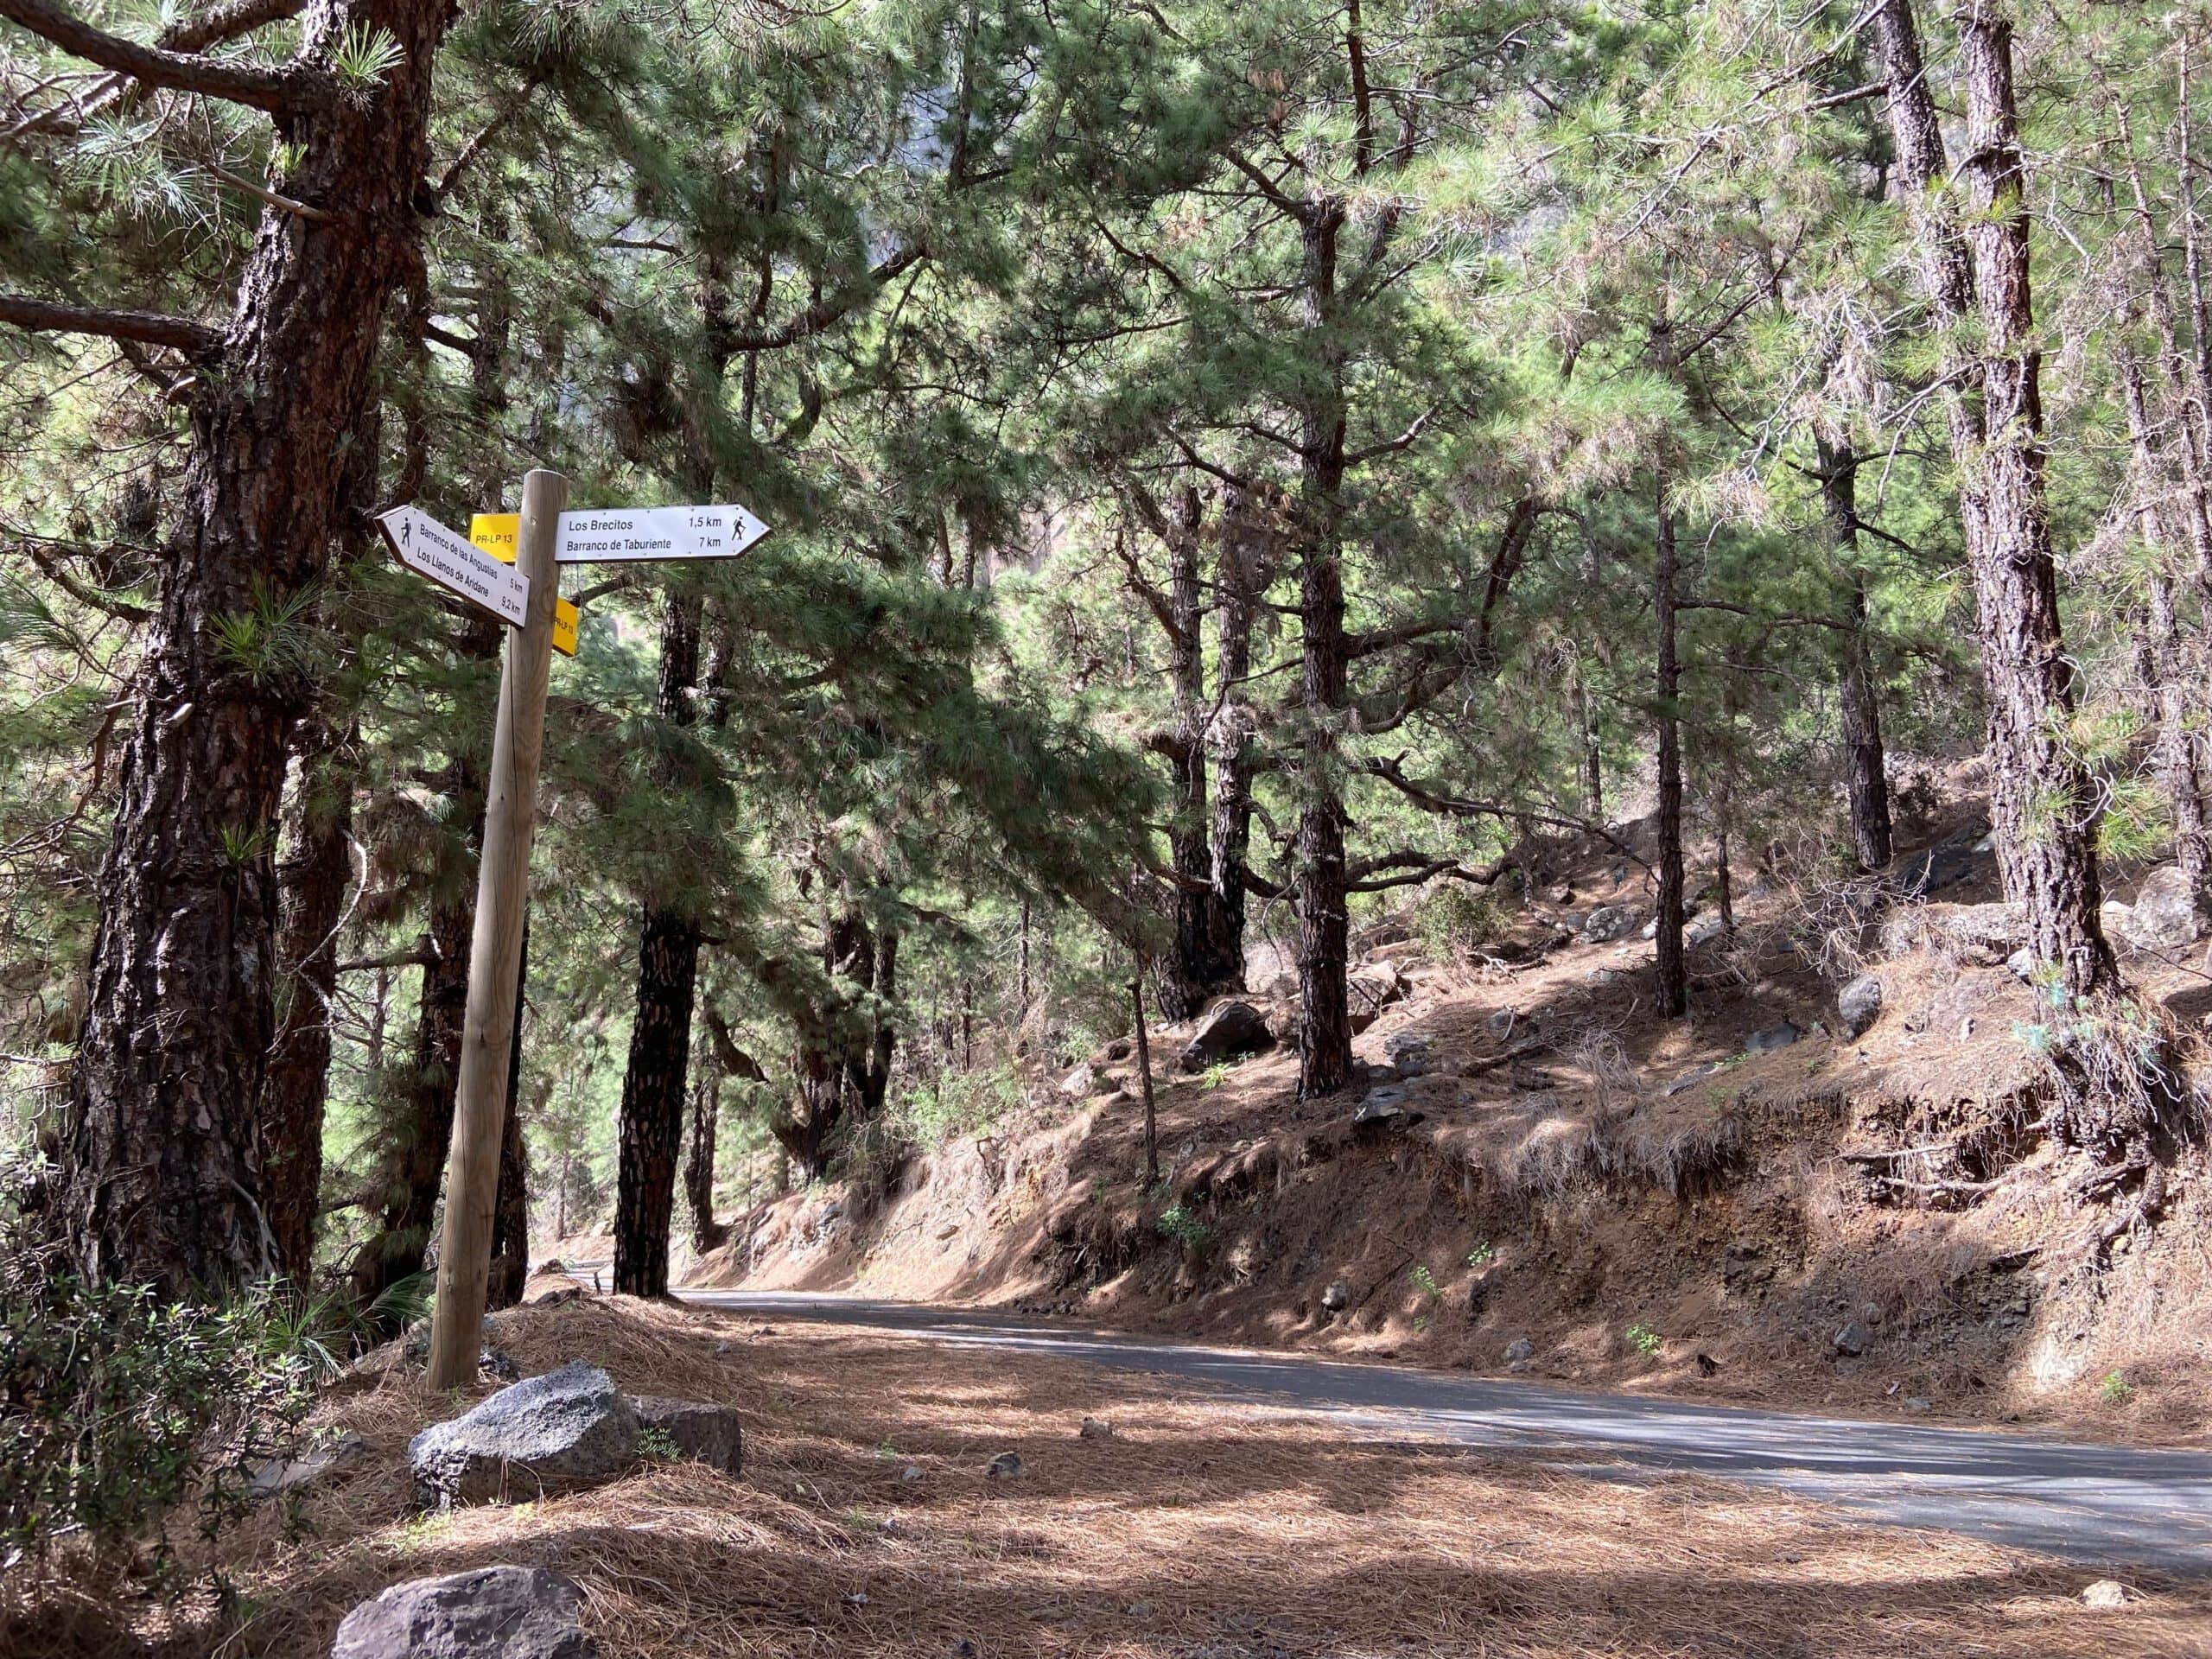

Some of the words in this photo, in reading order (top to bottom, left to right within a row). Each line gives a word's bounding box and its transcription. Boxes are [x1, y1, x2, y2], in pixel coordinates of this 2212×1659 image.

[569, 520, 589, 531] Los
[590, 518, 633, 531] Brecitos
[689, 518, 704, 529] 1,5
[706, 516, 721, 527] km
[476, 534, 501, 543] PR-LP
[503, 534, 512, 543] 13
[567, 540, 607, 551] Barranco
[610, 540, 621, 550] de
[625, 538, 671, 550] Taburiente
[699, 537, 704, 548] 7
[707, 537, 721, 547] km
[420, 524, 449, 550] Barranco
[450, 545, 458, 555] de
[459, 549, 468, 562] las
[469, 554, 498, 580] Angustias
[417, 546, 430, 562] Los
[432, 554, 454, 577] Llanos
[455, 570, 463, 582] de
[465, 575, 489, 598] Aridane
[510, 578, 514, 588] 5
[514, 582, 523, 594] km
[502, 595, 512, 608] 9,2
[512, 602, 520, 615] km
